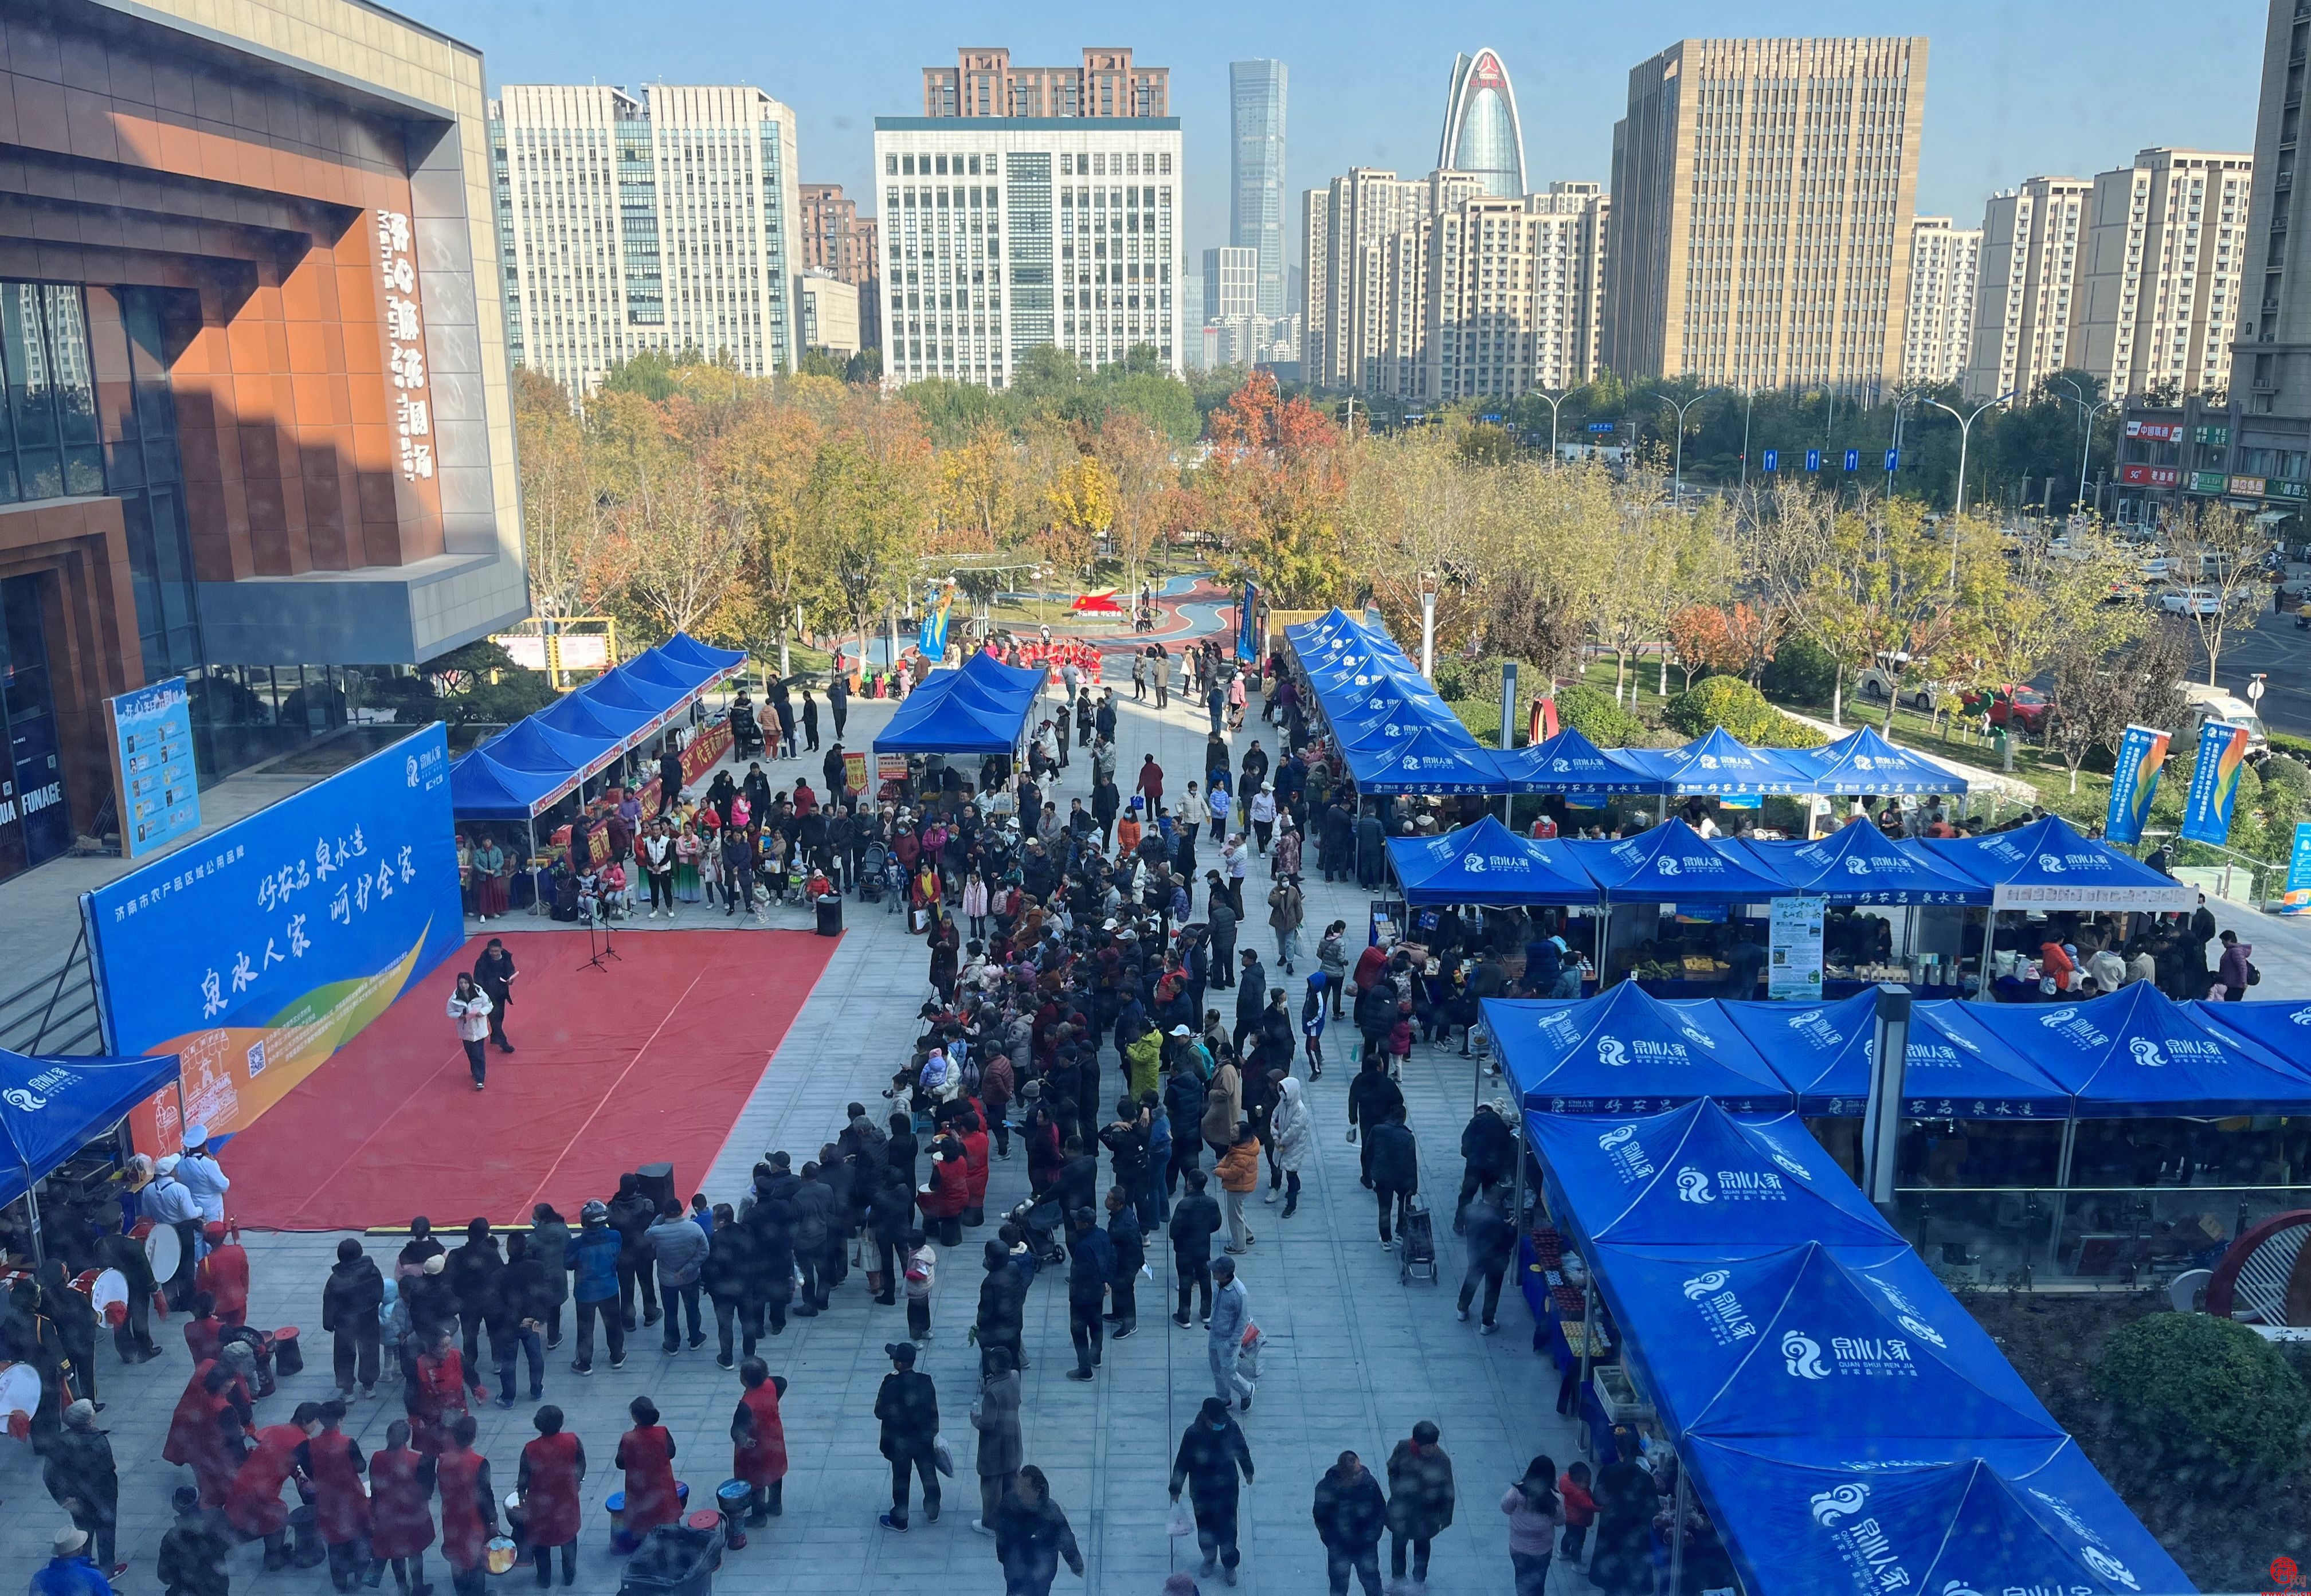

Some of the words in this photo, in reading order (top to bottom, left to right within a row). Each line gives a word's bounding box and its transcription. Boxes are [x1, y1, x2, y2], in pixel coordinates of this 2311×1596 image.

[377, 210, 395, 289] Mahua
[396, 393, 414, 481] Theater
[21, 781, 62, 816] FUNAGE
[1490, 856, 1529, 867] 泉水人家
[1683, 856, 1723, 867] 泉水人家
[1871, 857, 1912, 868] 泉水人家
[2065, 854, 2108, 864] 泉水人家
[114, 844, 245, 923] 济南市农产品区域公用品牌
[1859, 892, 1909, 903] 好农品
[1922, 892, 1967, 904] 泉水造
[201, 913, 312, 1019] 泉水人家
[329, 845, 416, 925] 呵护全家
[2068, 1018, 2109, 1046] 泉水人家
[1632, 1040, 1687, 1057] 泉水人家
[2165, 1039, 2222, 1055] 泉水人家
[1973, 1100, 2034, 1116] 泉水造
[1621, 1141, 1654, 1178] 泉水人家
[1717, 1171, 1782, 1189] 泉水人家
[1711, 1291, 1757, 1340] 泉水人家
[1831, 1337, 1911, 1361] 泉水人家
[1841, 1530, 1855, 1550] QUAN
[1852, 1550, 1866, 1567] SHUI
[1862, 1568, 1875, 1584] REN
[1870, 1585, 1882, 1596] JIA
[1849, 1517, 1910, 1593] 泉水人家
